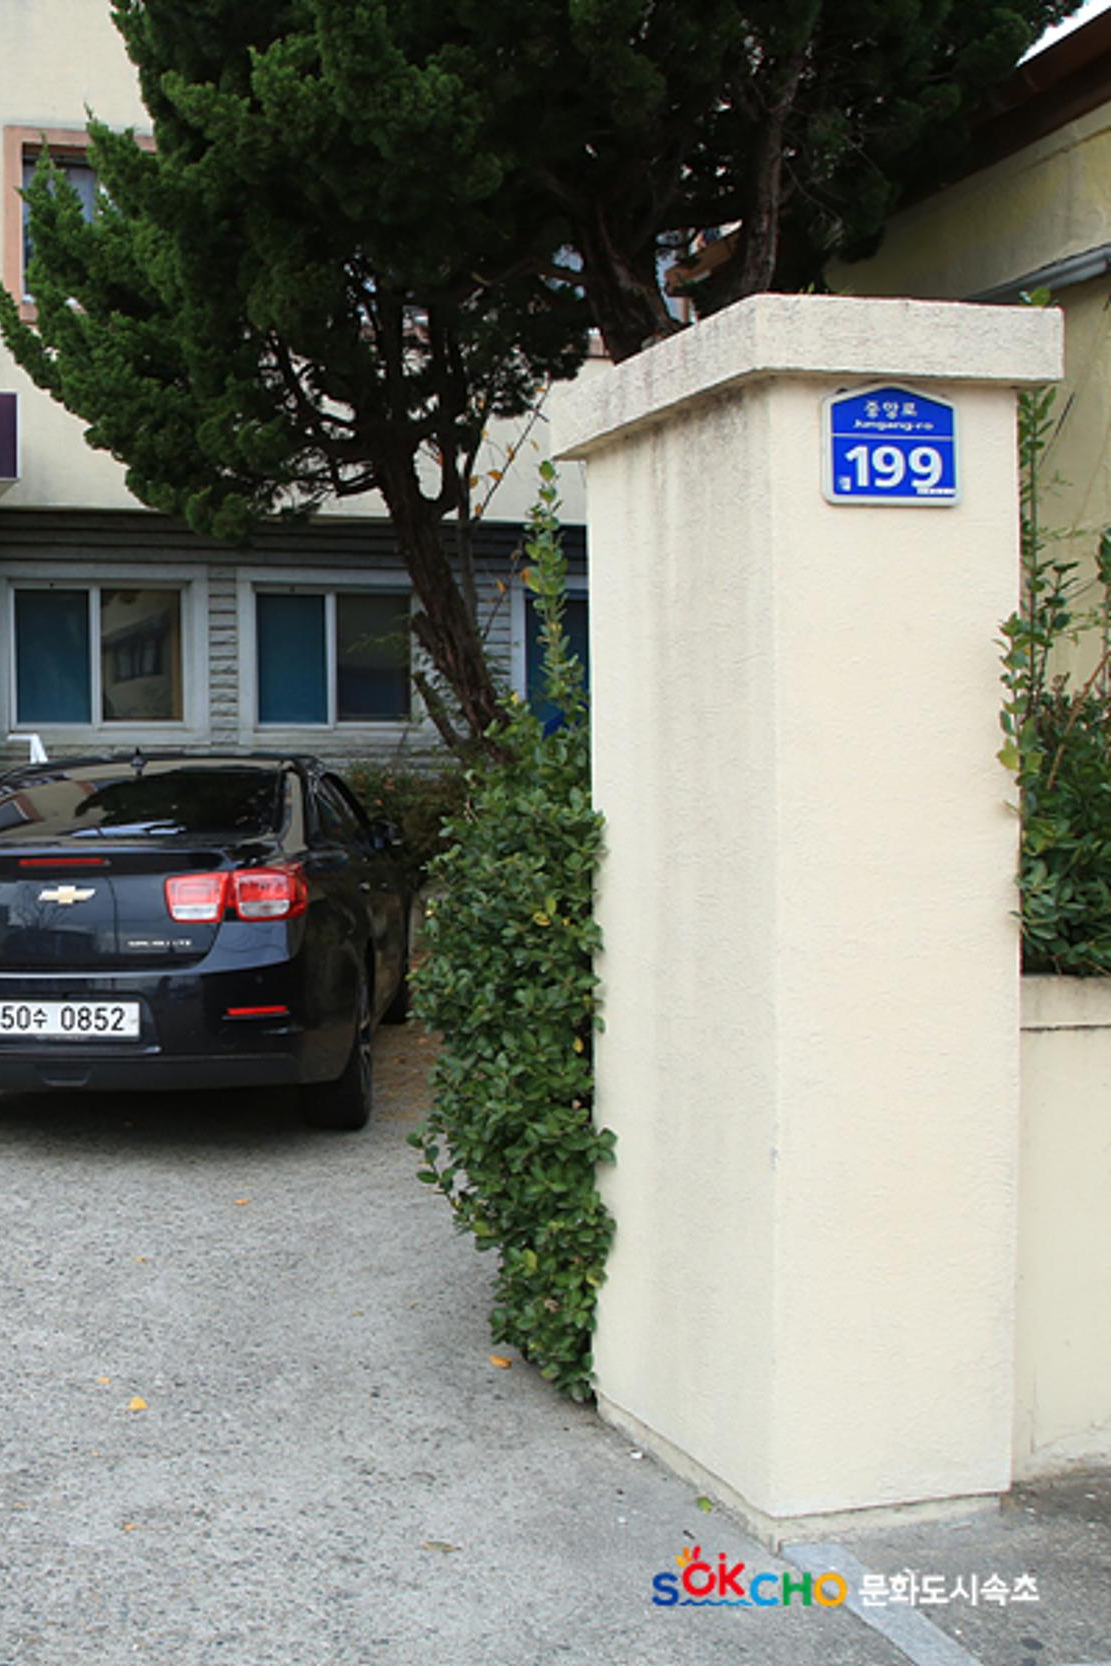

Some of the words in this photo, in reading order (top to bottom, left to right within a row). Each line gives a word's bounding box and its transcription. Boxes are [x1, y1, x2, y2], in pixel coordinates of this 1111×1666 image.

[845, 445, 943, 488] 199
[0, 1005, 48, 1029] 50수
[60, 1005, 125, 1031] 0852
